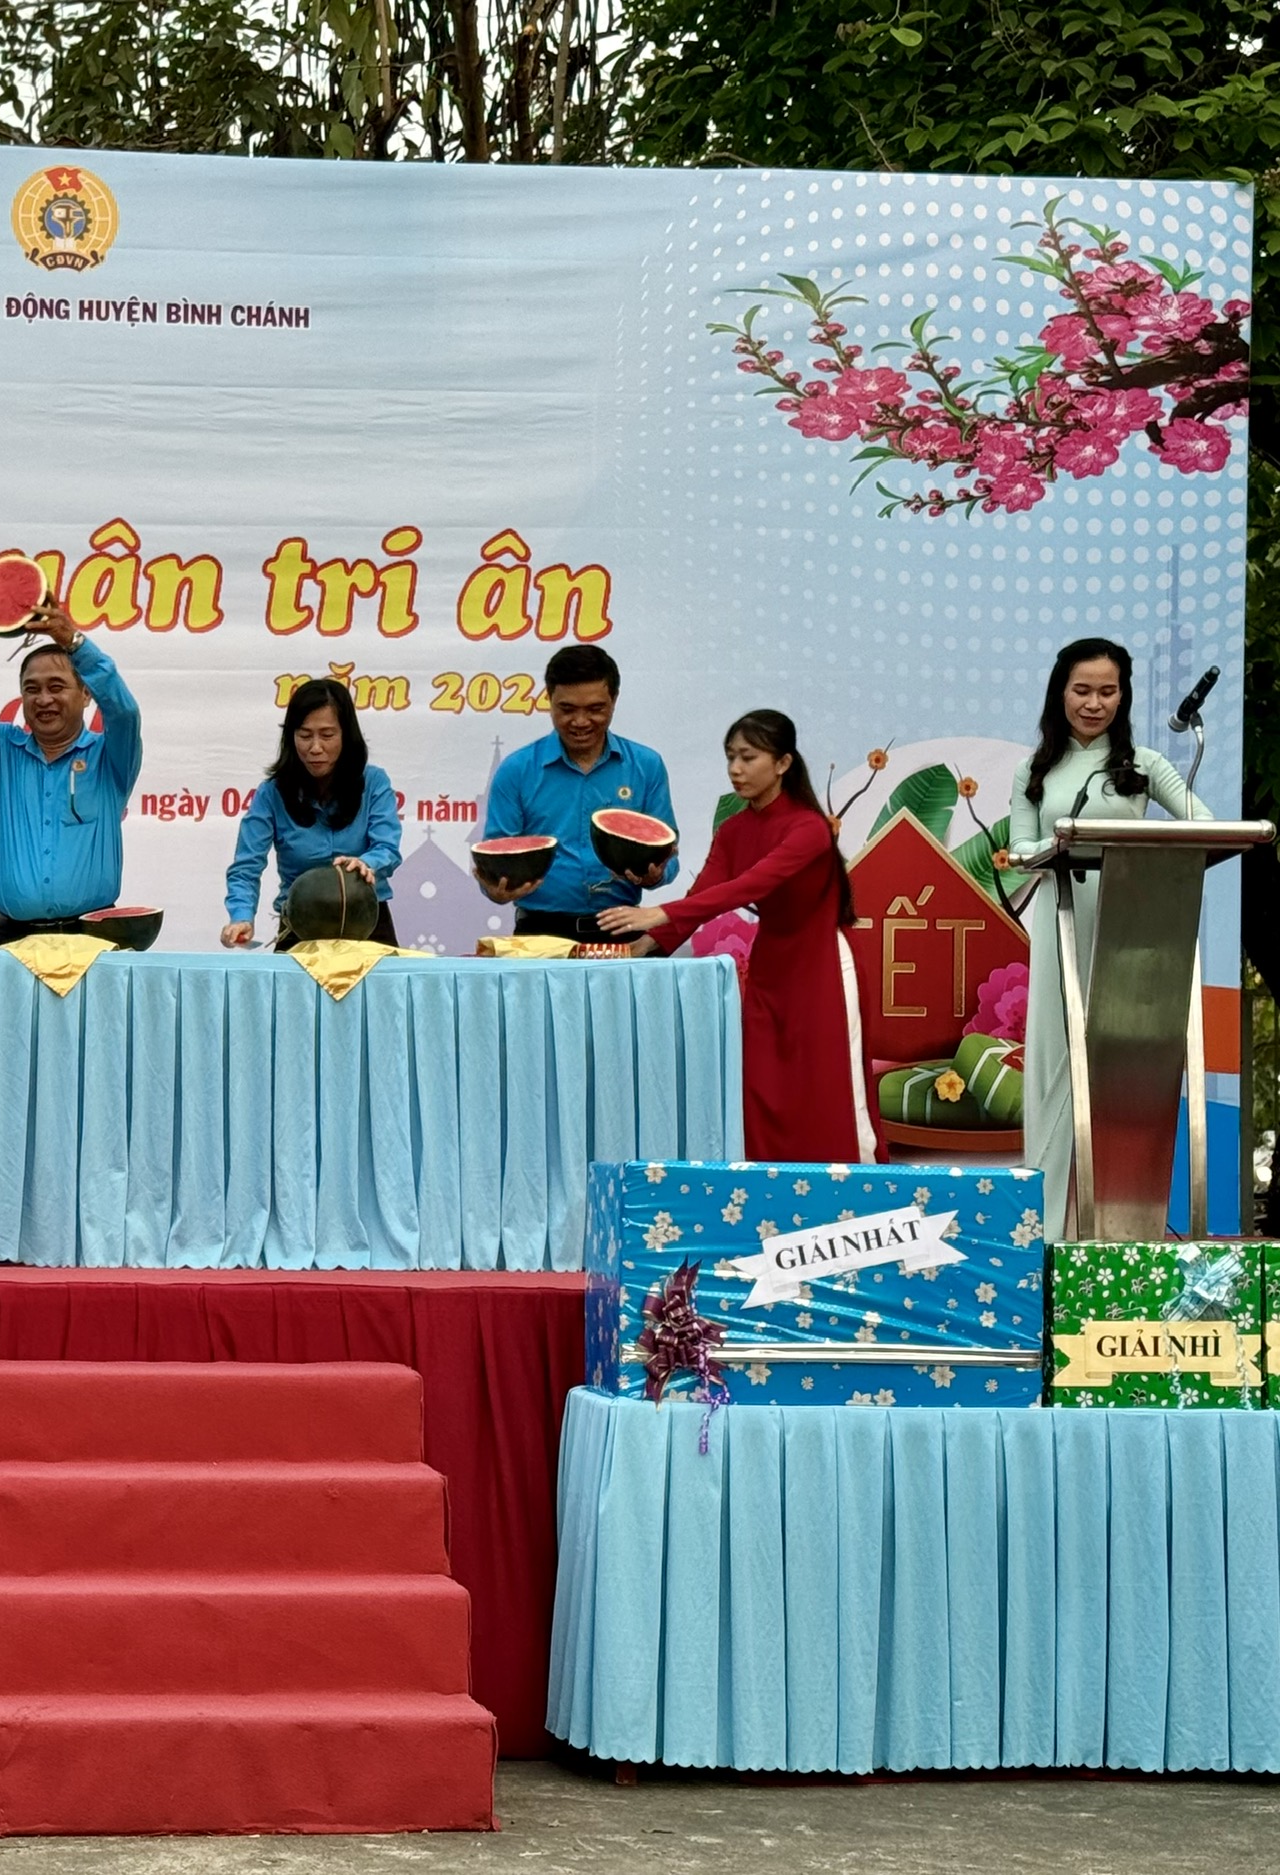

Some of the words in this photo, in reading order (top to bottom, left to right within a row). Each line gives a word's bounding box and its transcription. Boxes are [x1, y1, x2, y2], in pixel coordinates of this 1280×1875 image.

[46, 255, 84, 268] CĐVN
[5, 292, 70, 324] ĐỘNG
[78, 296, 157, 327] HUYỆN
[166, 297, 222, 326] BÌNH
[231, 301, 310, 329] CHÁNH
[262, 525, 423, 638] tri
[457, 528, 613, 642] ân
[429, 671, 551, 716] 202
[141, 787, 211, 822] ngày
[417, 794, 477, 822] năm
[852, 885, 985, 1017] ẾT
[775, 1235, 838, 1270] GIẢI
[840, 1218, 920, 1256] NHẤT
[1096, 1329, 1162, 1358] GIẢI
[1167, 1329, 1222, 1358] NHÌ
